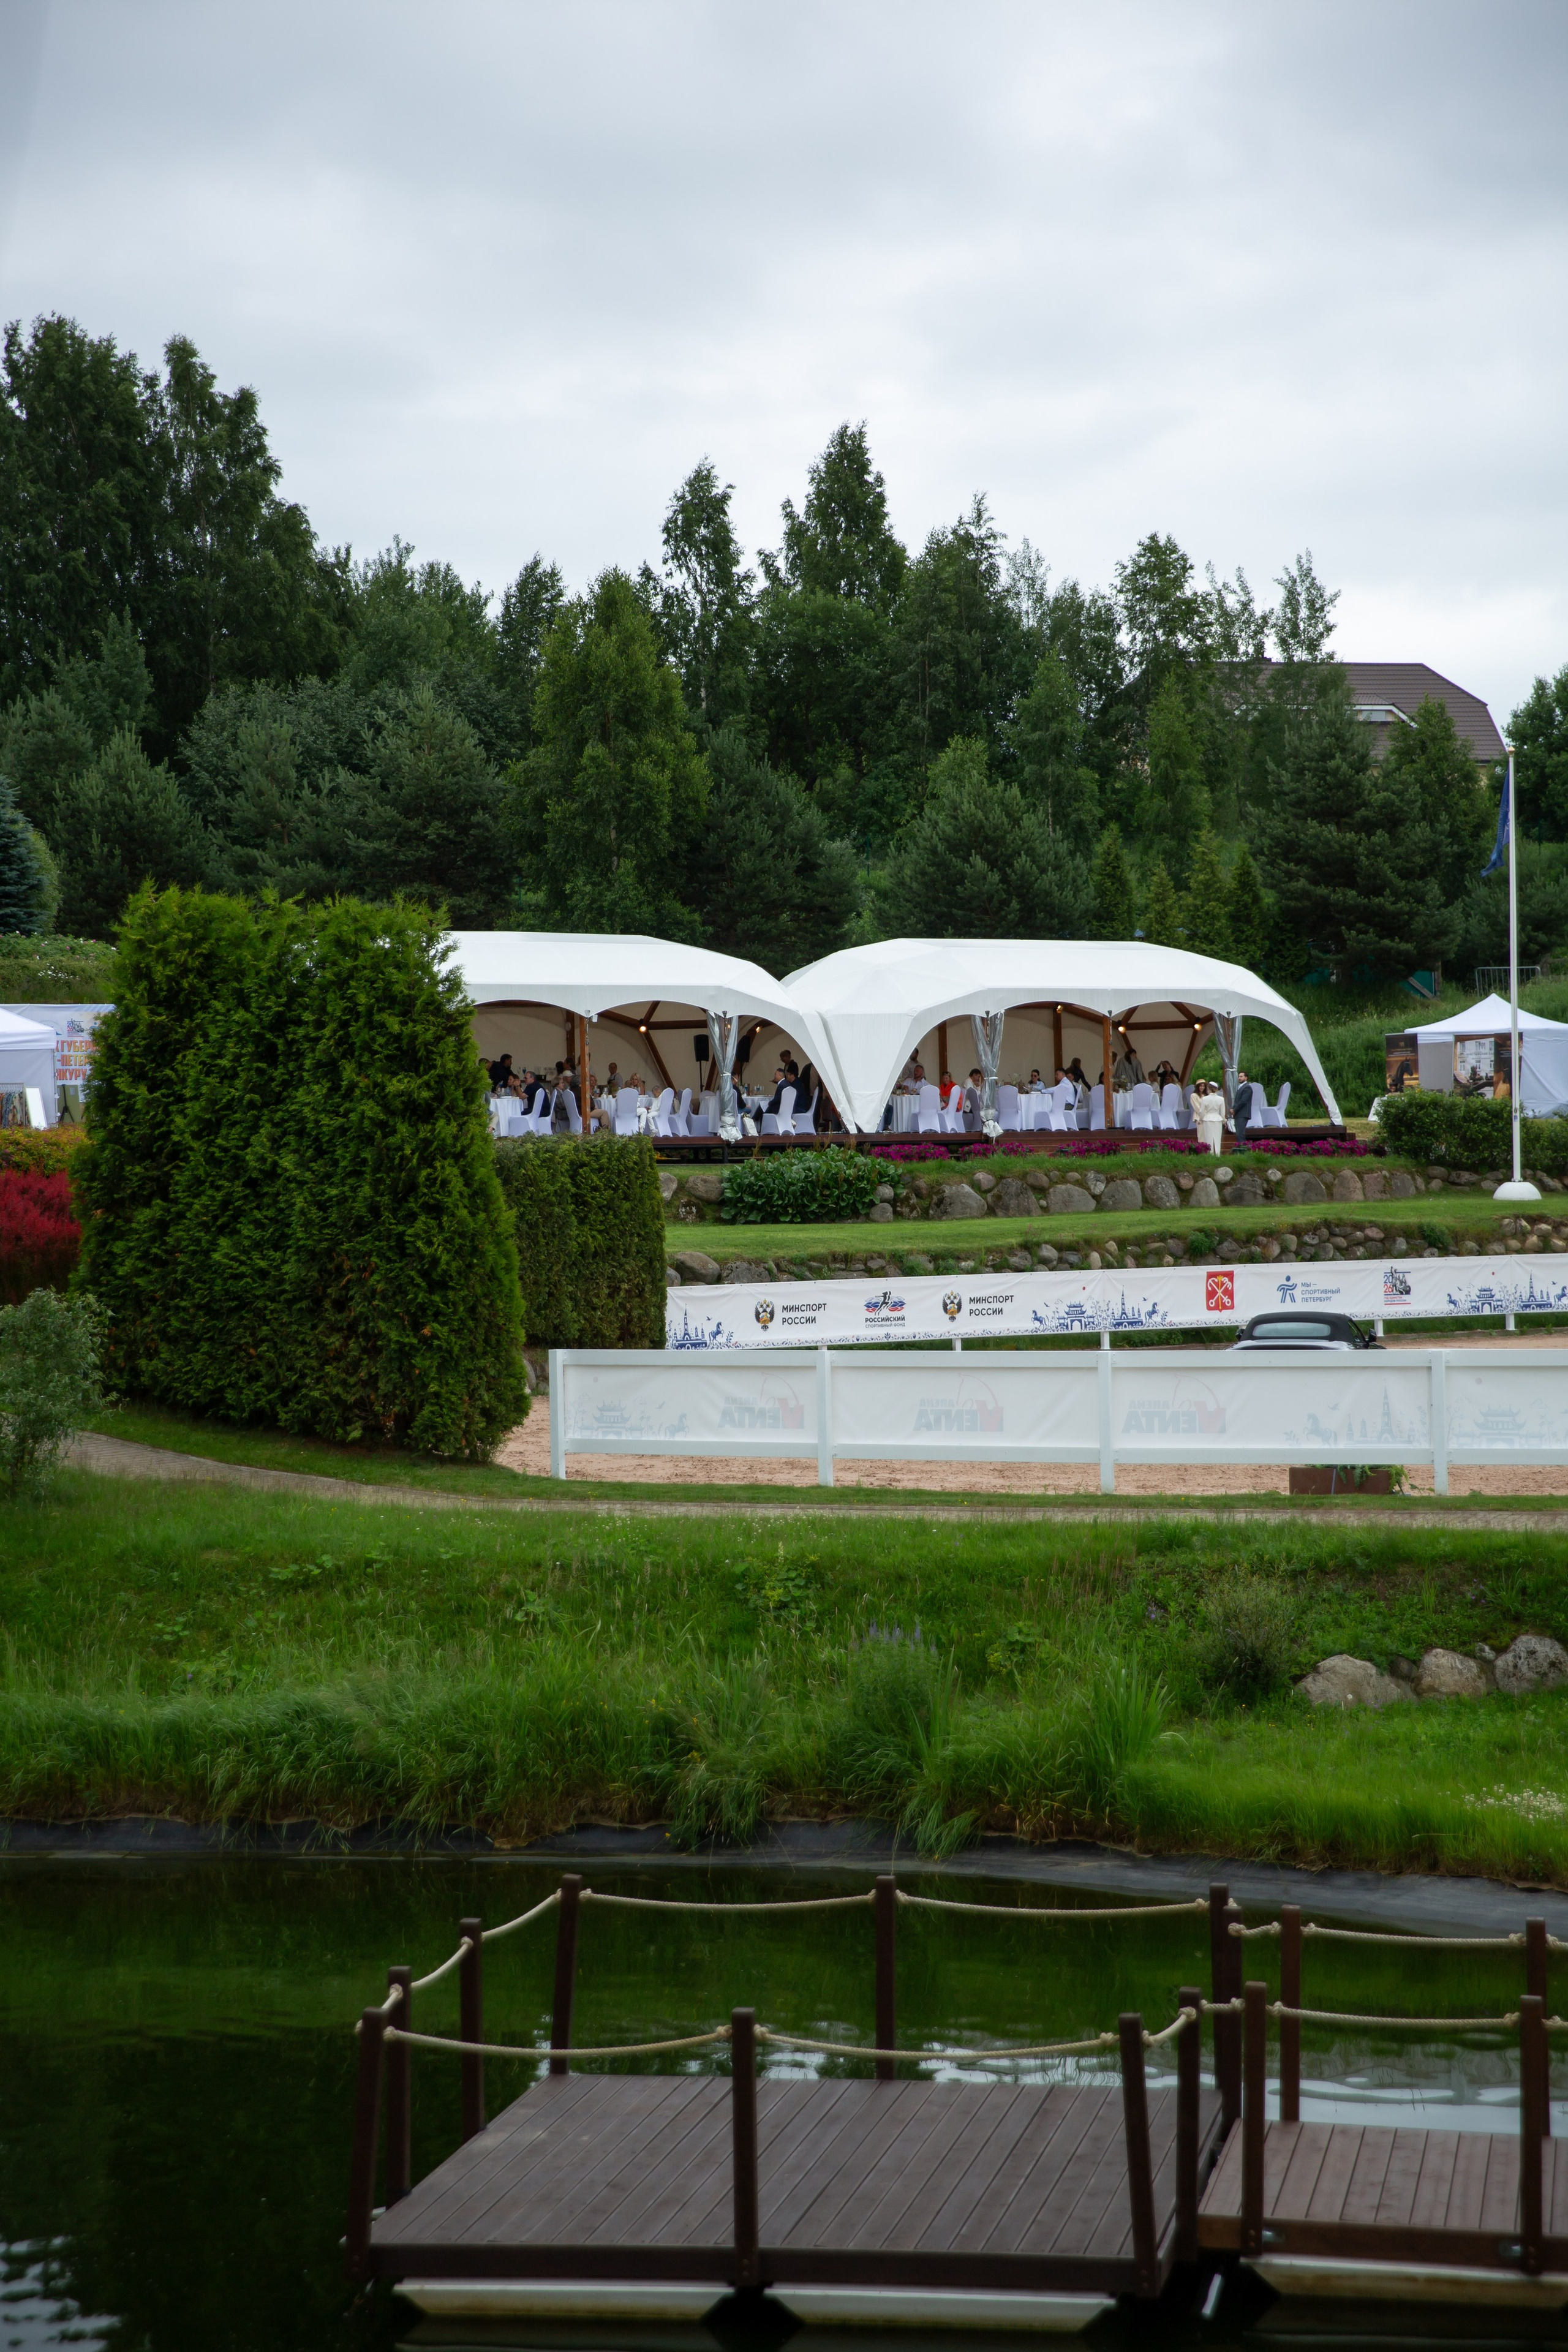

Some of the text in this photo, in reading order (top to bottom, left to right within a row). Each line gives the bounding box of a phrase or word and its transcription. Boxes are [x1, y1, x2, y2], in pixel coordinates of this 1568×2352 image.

[56, 1069, 87, 1080] НКУРУ
[1384, 1275, 1393, 1284] 20
[1384, 1284, 1393, 1293] 26
[969, 1295, 1014, 1304] МИНСПОРТ
[782, 1303, 827, 1313] МИНСПОРТ
[970, 1308, 1003, 1316] РОССИИ
[782, 1316, 816, 1325] РОССИИ
[865, 1314, 905, 1323] РОССИЙСКИЙ
